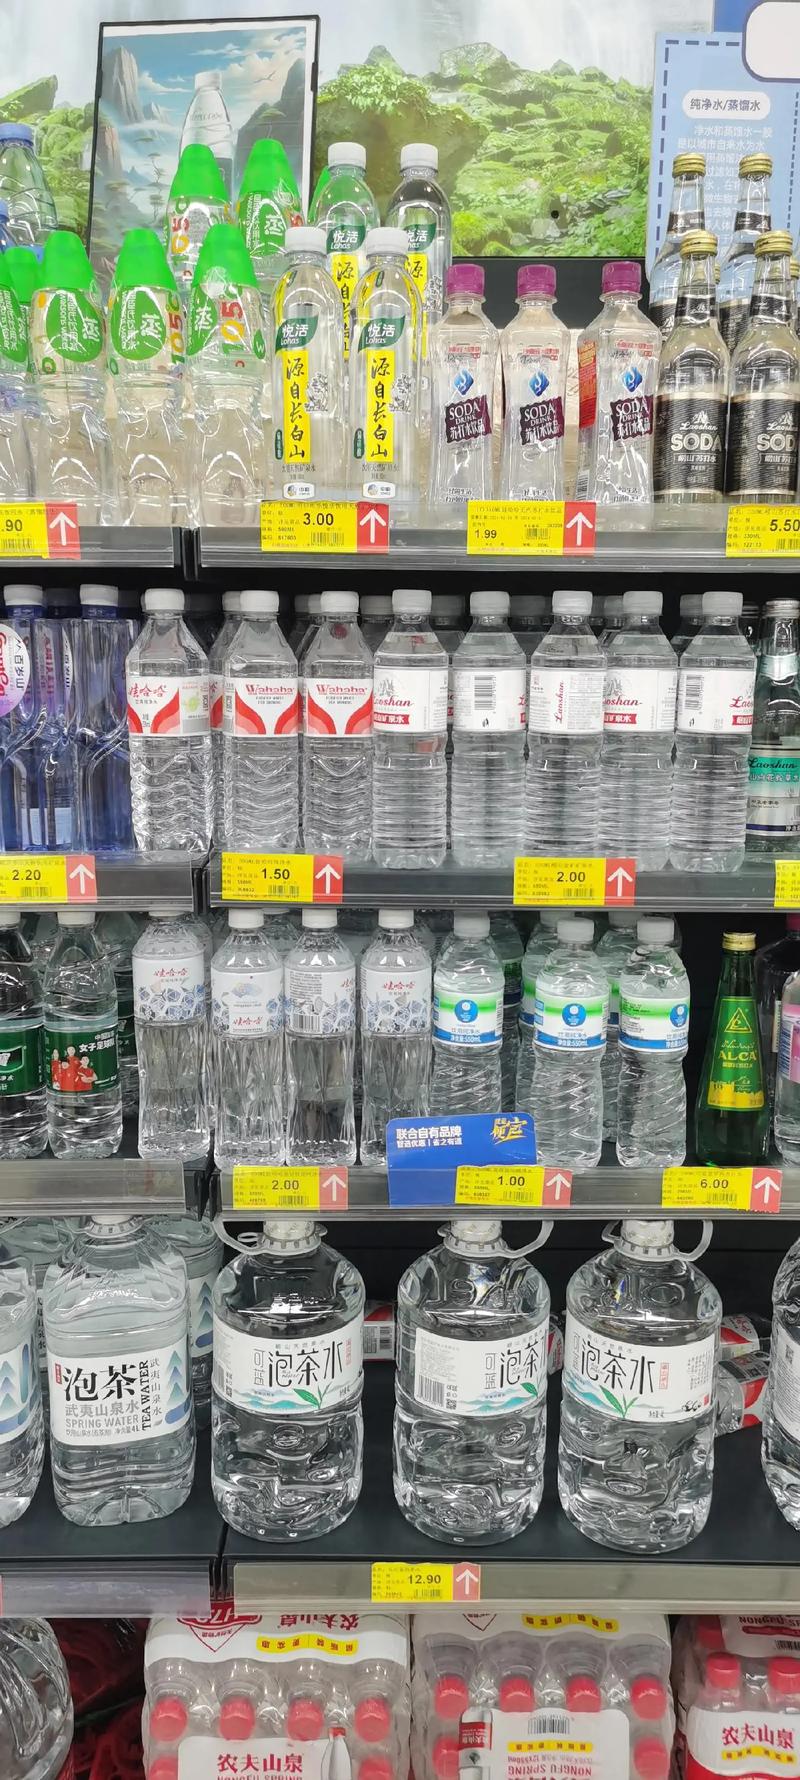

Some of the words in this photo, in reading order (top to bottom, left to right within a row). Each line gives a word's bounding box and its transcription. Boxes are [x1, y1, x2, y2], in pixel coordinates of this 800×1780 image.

[689, 97, 761, 112] 纯净水/蒸馏水
[333, 228, 359, 244] 悦活
[281, 321, 309, 339] 悦活
[366, 320, 396, 338] 悦活
[280, 336, 301, 346] Lohas
[364, 335, 387, 346] Lohas
[286, 357, 306, 459] 源自长白山
[370, 357, 392, 459] 源自长白山
[449, 400, 480, 420] SODA
[524, 402, 556, 422] SODA
[615, 398, 649, 418] SODA
[455, 414, 477, 425] DRINK
[530, 415, 553, 427] DRINK
[679, 421, 718, 431] Laoshan
[670, 432, 723, 452] SODA
[303, 512, 334, 526] 3.00
[769, 518, 800, 532] 5.50
[474, 529, 497, 539] 1.99
[127, 682, 166, 698] 娃哈哈
[245, 683, 294, 695] Wahaha
[316, 683, 367, 696] Wahaha
[748, 757, 797, 769] Laoshan
[12, 869, 42, 881] 2.20
[261, 868, 291, 880] 1.50
[556, 871, 586, 883] 2.00
[718, 1050, 757, 1061] ALCA
[395, 1125, 463, 1140] 联合自有品牌
[271, 1179, 300, 1191] 2.00
[497, 1175, 526, 1187] 1.00
[700, 1179, 729, 1189] 6.00
[268, 1341, 344, 1388] 泡茶水
[581, 1338, 656, 1395] 泡茶水
[62, 1363, 139, 1402] 泡茶
[139, 1360, 151, 1405] WATER
[150, 1357, 163, 1417] 武夷山泉水
[65, 1399, 140, 1418] 武夷山泉水
[66, 1418, 102, 1429] SPRING
[104, 1414, 139, 1428] WATER
[141, 1405, 152, 1432] TEA
[407, 1574, 442, 1584] 12.90
[722, 1723, 795, 1750] 农夫山泉
[217, 1753, 303, 1774] 农夫山泉
[507, 1764, 546, 1776] SPRING
[550, 1764, 592, 1776] NONGFU
